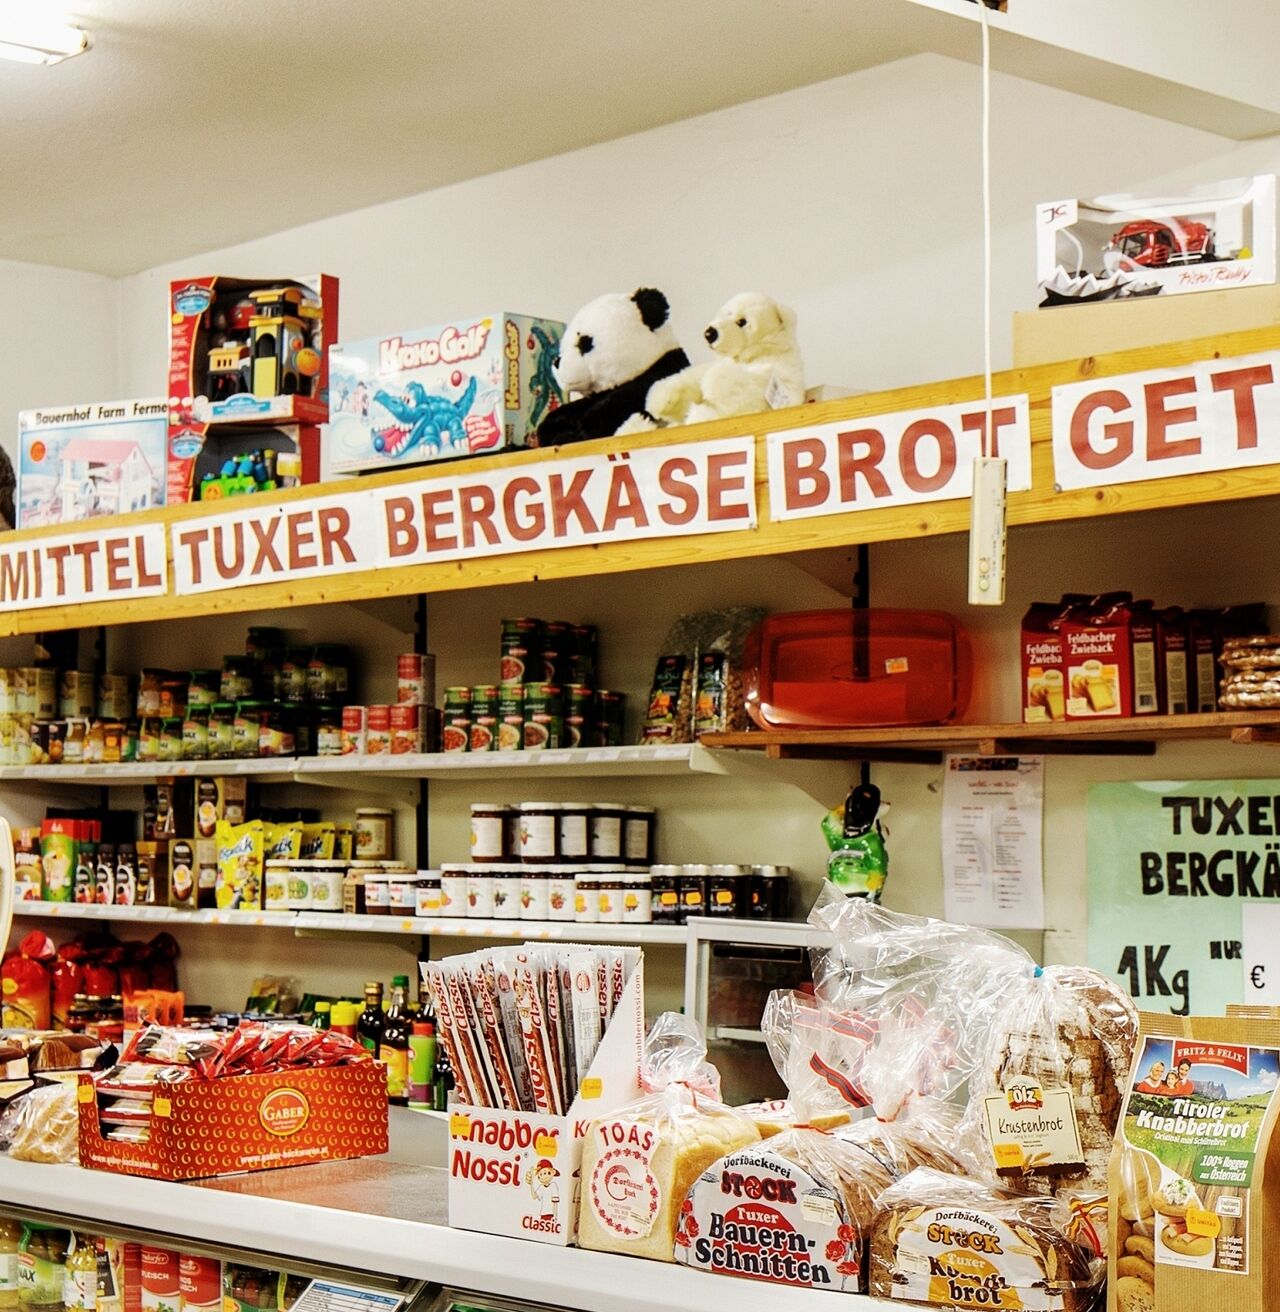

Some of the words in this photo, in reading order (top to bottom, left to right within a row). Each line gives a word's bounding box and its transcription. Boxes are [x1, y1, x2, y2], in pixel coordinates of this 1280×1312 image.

[35, 407, 90, 425] Bauernhof
[98, 407, 125, 420] Farm
[783, 406, 1017, 511] BROT
[180, 506, 356, 584] TUXER
[385, 451, 750, 559] BERGKÄSE
[1067, 631, 1116, 647] Feldbacher
[1070, 642, 1113, 656] Zwieback
[1250, 965, 1266, 990] €
[1177, 1046, 1204, 1059] FRITZ
[1217, 1049, 1244, 1062] FELIX
[1012, 1085, 1037, 1104] Ölz
[264, 1106, 306, 1122] GABER
[1172, 1097, 1230, 1119] Tiroler
[999, 1114, 1064, 1135] Krustenbrot
[1136, 1108, 1250, 1139] Knabberbrot
[452, 1149, 521, 1187] Nossi
[723, 1154, 792, 1179] Dorfbäckerei
[1210, 1166, 1247, 1182] Österreich
[522, 1214, 561, 1235] Classic
[736, 1205, 780, 1225] Tuxer
[935, 1211, 998, 1235] Dorfbäckerei
[709, 1211, 817, 1254] Bauern-
[694, 1236, 832, 1285] Schnitten
[946, 1252, 987, 1269] Tuxer
[948, 1280, 1003, 1305] brot
